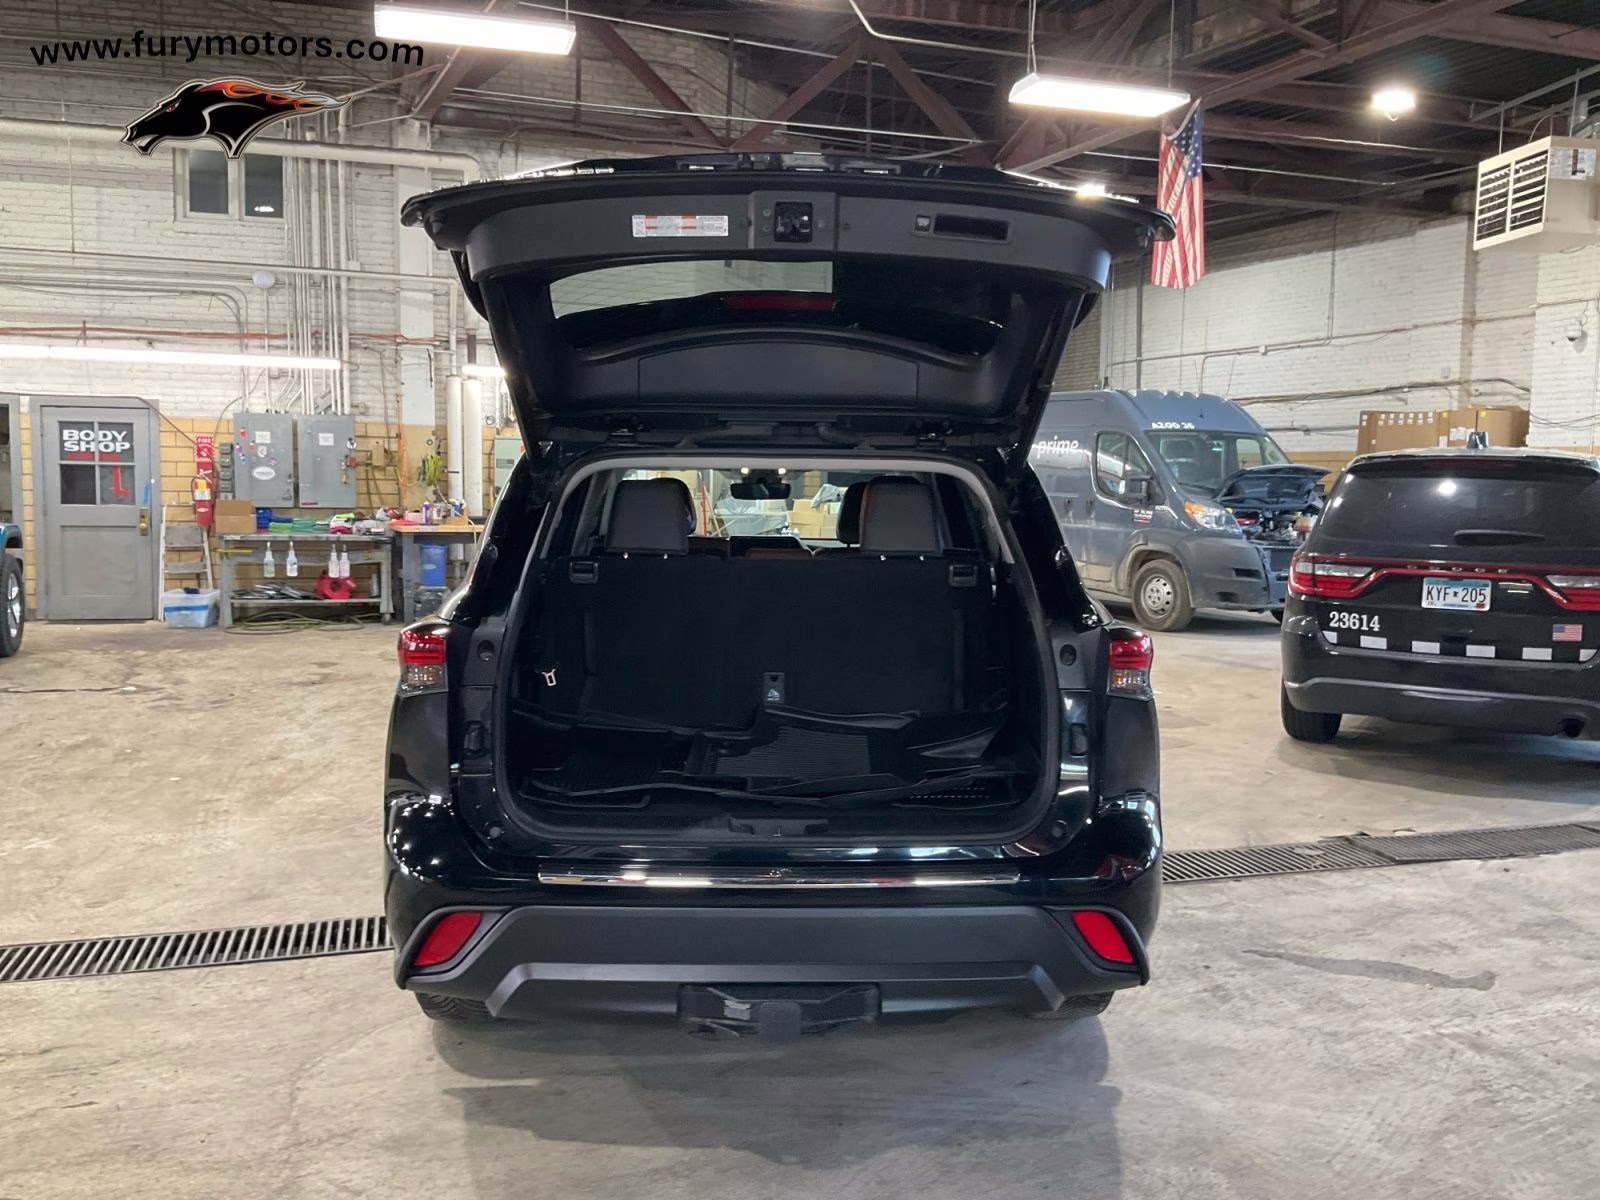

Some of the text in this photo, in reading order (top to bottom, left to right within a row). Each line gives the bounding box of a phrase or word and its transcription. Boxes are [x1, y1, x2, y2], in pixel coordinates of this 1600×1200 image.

[62, 429, 128, 441] BODY
[64, 441, 131, 453] SHOP
[1036, 435, 1079, 459] prime
[1426, 585, 1487, 603] KYF 205
[1329, 611, 1381, 632] 23614
